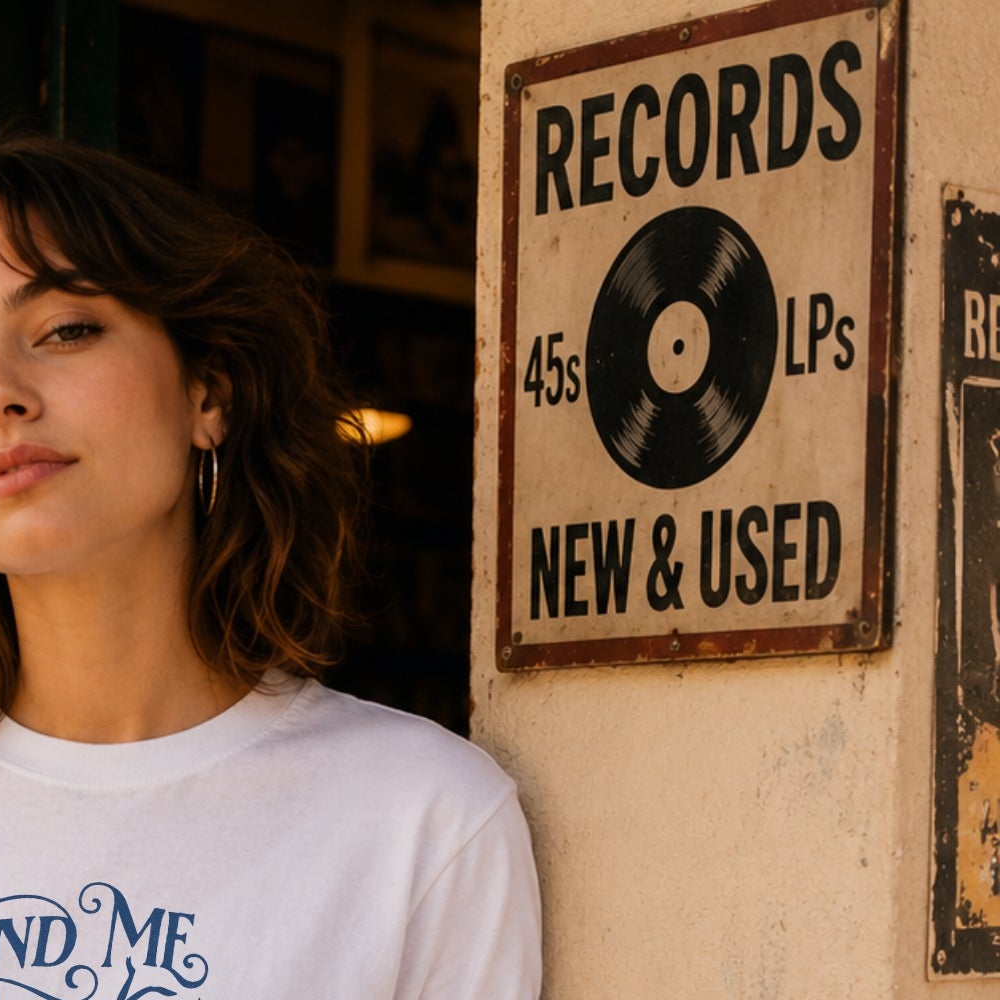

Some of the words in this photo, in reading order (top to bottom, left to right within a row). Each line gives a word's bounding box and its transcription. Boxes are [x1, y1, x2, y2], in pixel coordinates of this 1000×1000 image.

[535, 40, 863, 215] RECORDS
[524, 332, 581, 408] 45s
[785, 292, 855, 377] LPs
[529, 517, 636, 621] NEW
[646, 513, 684, 612] &
[700, 500, 842, 609] USED
[79, 882, 209, 988] ME
